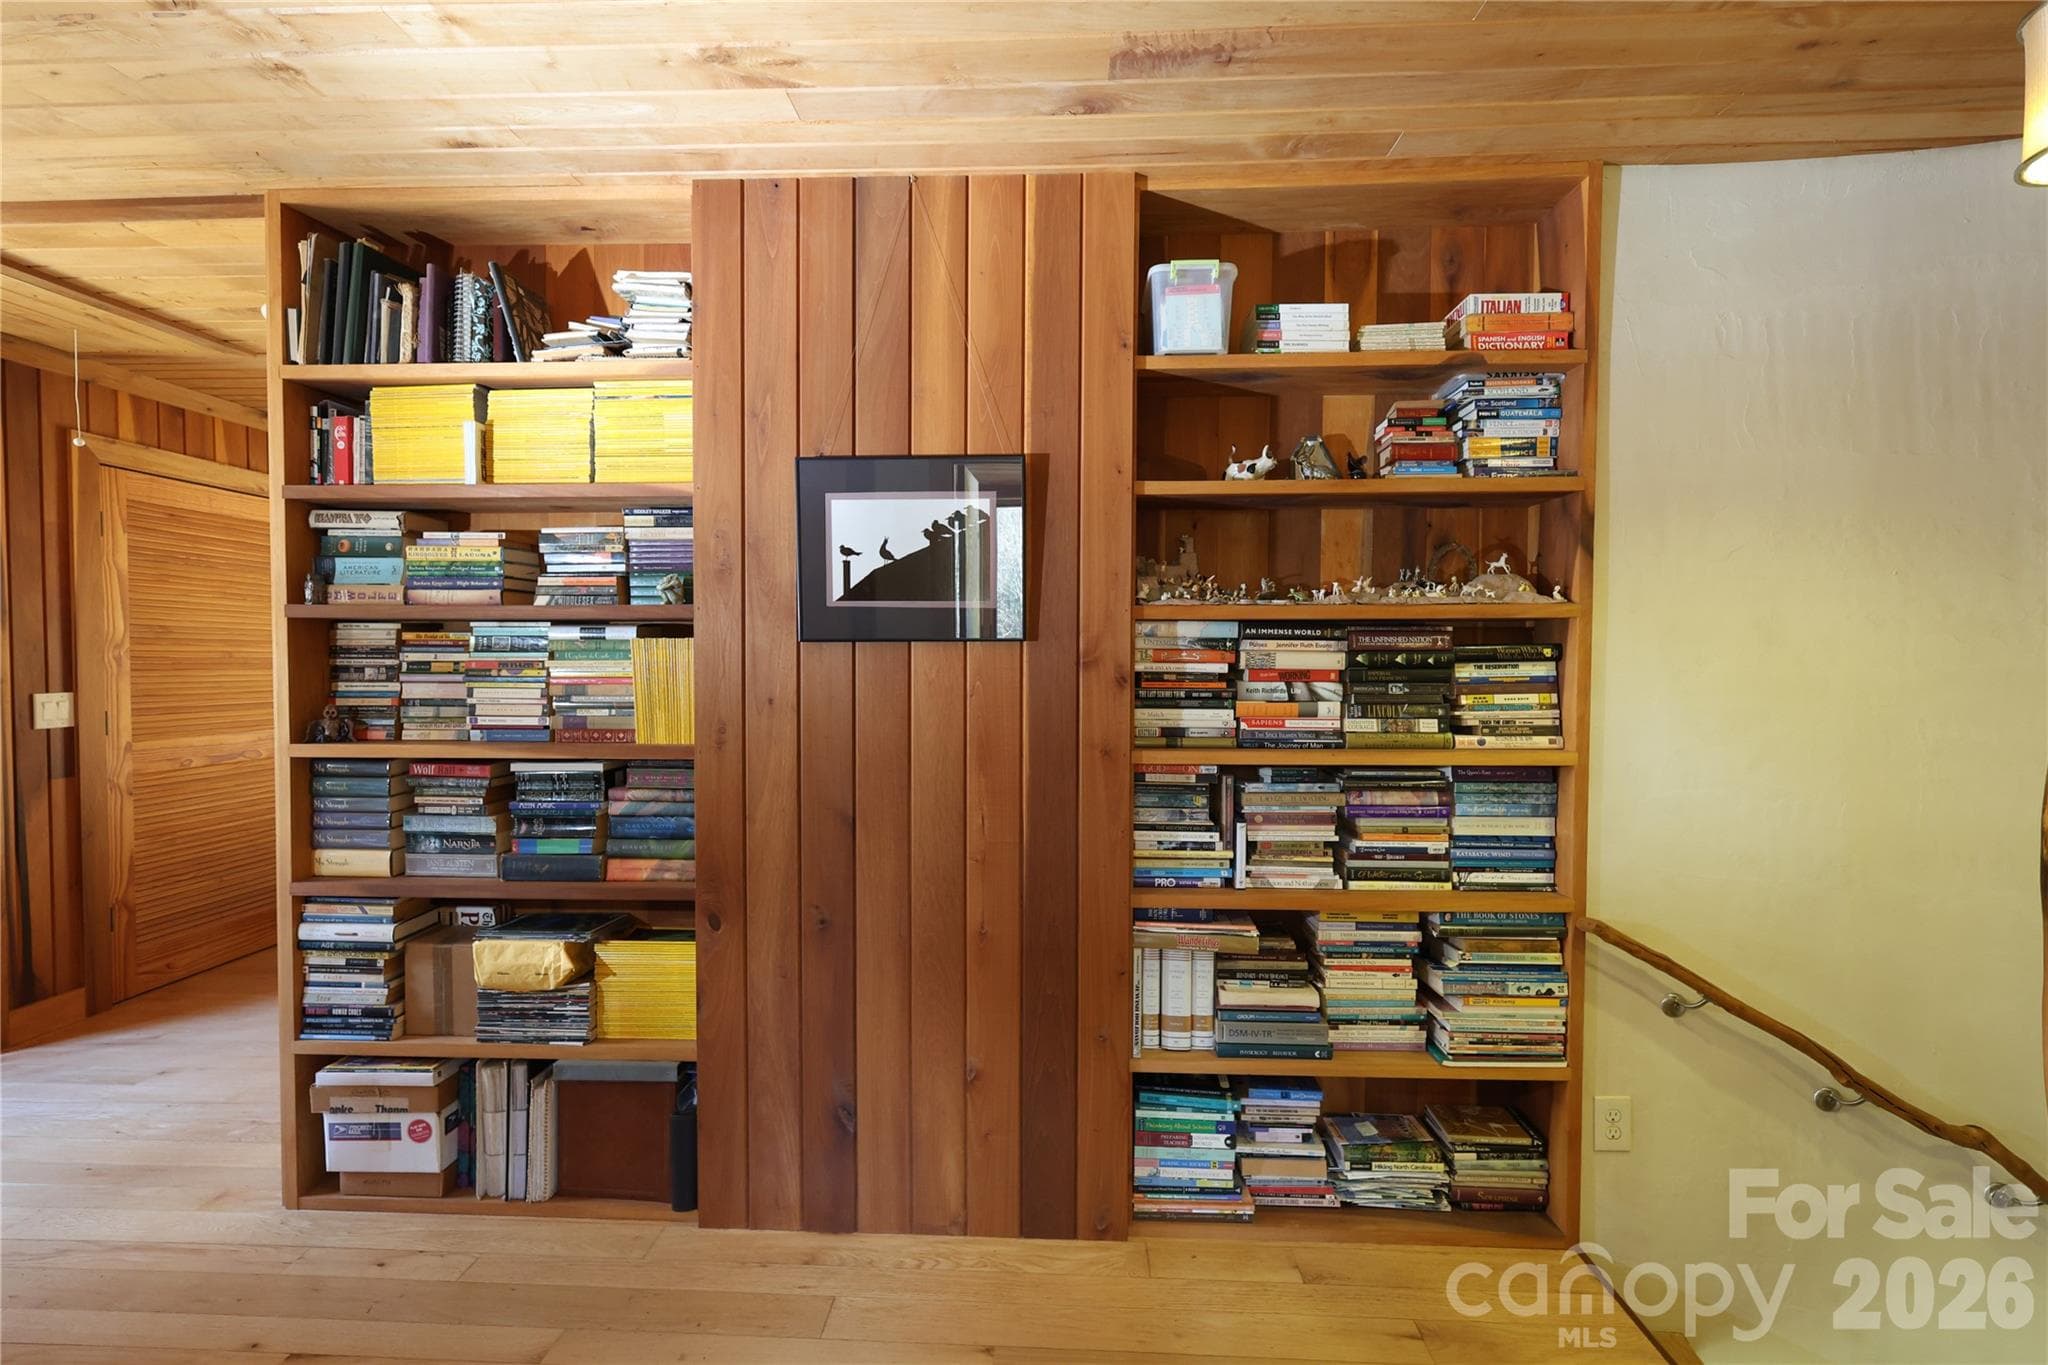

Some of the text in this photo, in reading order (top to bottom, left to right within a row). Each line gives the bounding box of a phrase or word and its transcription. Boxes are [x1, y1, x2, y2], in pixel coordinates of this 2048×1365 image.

[1481, 299, 1521, 313] ITALIAN
[1478, 341, 1545, 350] DICTIONARY
[1258, 628, 1292, 636] IMMENSE
[1275, 641, 1298, 650] Jennifer
[1279, 671, 1311, 681] WORKING
[1245, 687, 1261, 695] Keith
[1261, 687, 1287, 695] Richards
[1278, 742, 1302, 750] Journey
[412, 764, 435, 775] Wolf
[442, 838, 481, 850] NARNIA
[1154, 877, 1176, 887] PRO
[1473, 912, 1496, 920] BOOK
[1507, 912, 1540, 920] STONES
[1228, 1028, 1273, 1039] DSM-IV-TR
[1373, 1162, 1393, 1171] Hiking
